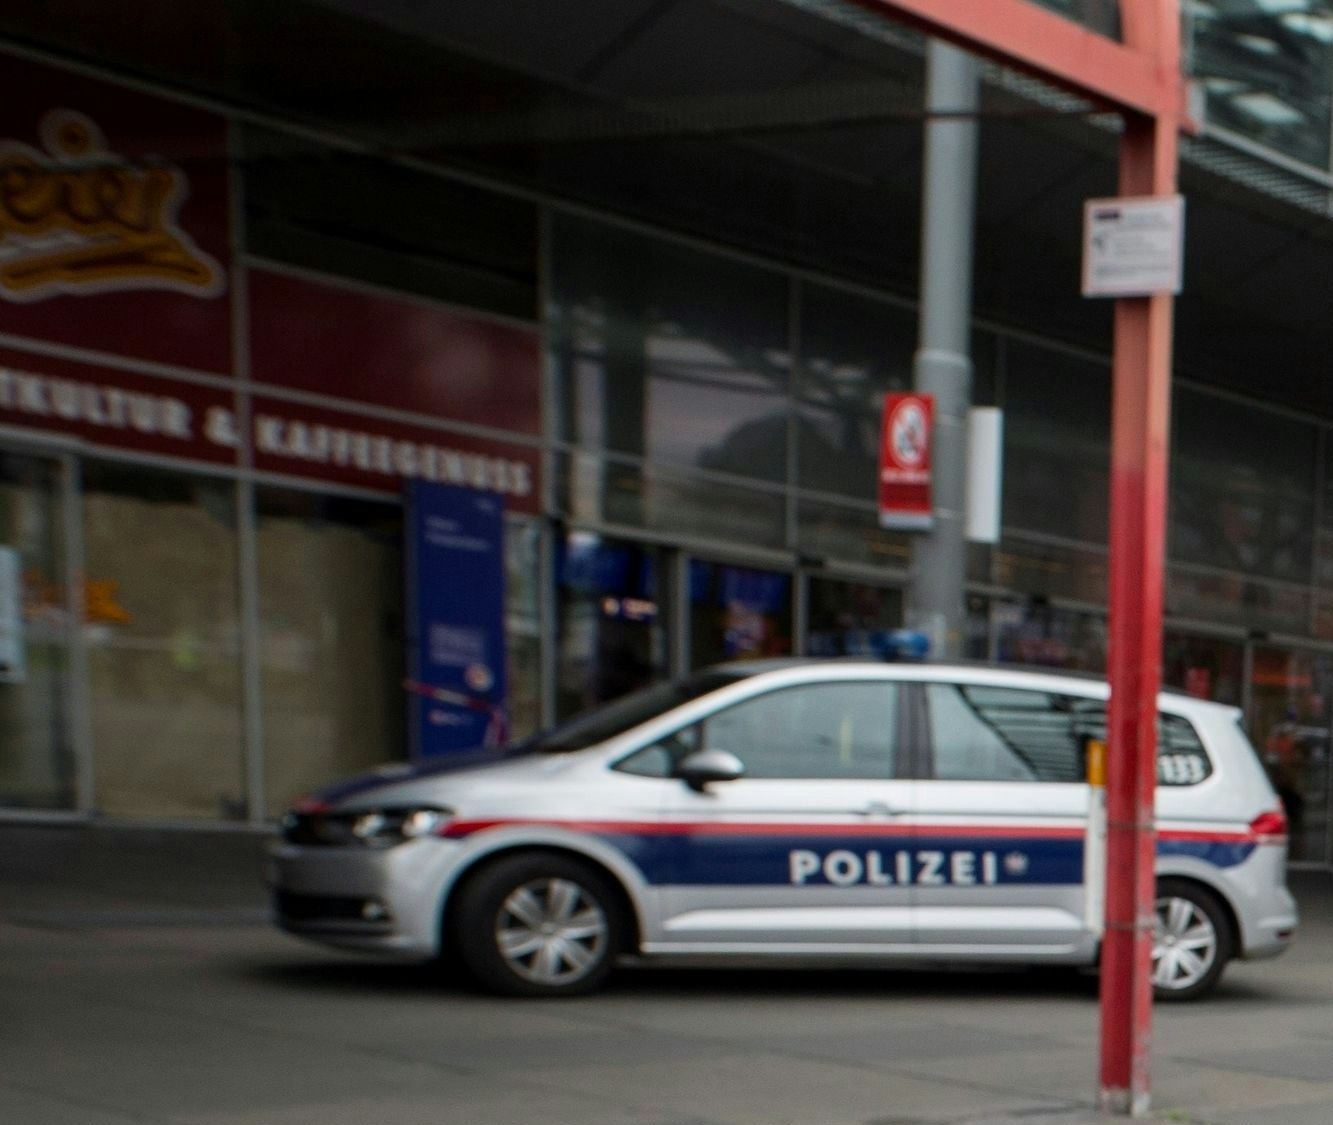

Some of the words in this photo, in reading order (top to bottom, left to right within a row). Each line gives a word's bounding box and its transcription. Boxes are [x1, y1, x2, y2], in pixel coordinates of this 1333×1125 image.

[205, 406, 240, 446] &
[256, 413, 531, 496] KAFFEEGENUSS
[788, 849, 998, 886] POLIZEI
